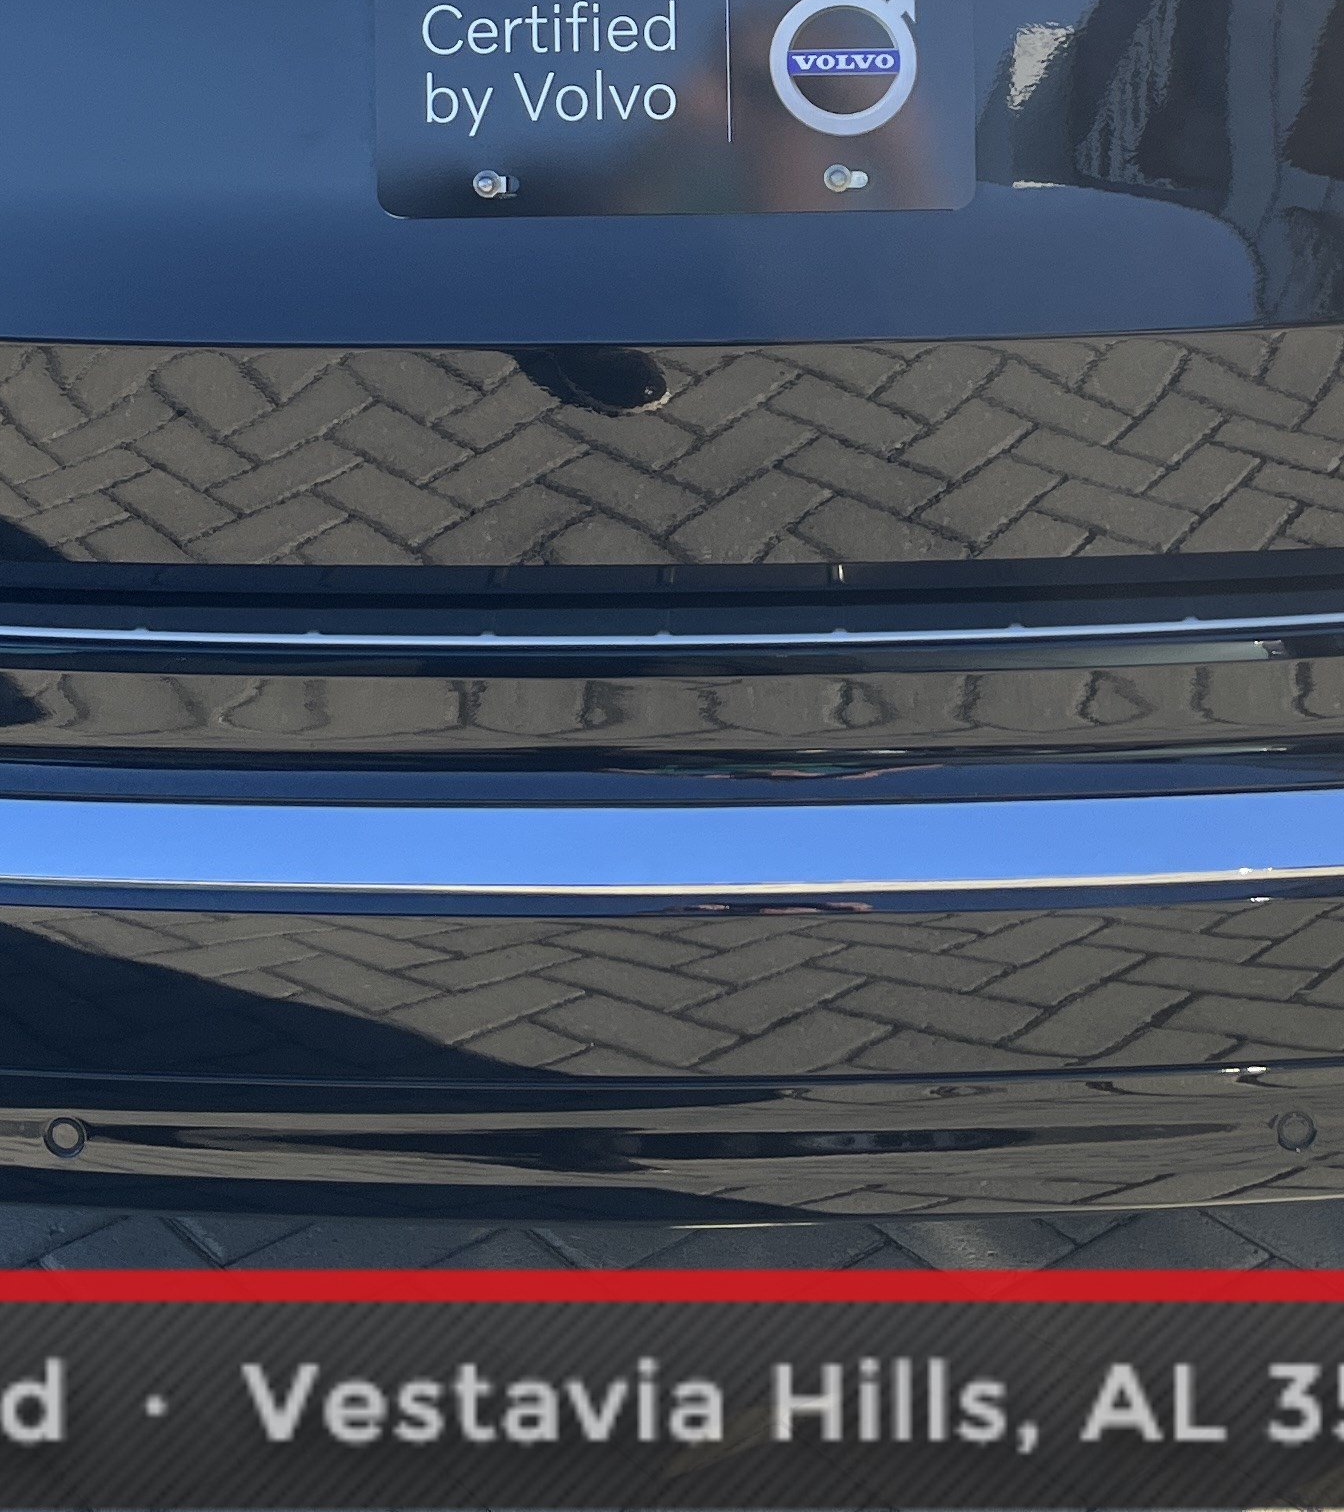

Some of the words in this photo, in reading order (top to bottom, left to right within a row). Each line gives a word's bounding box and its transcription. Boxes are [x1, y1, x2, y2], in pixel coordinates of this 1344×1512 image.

[422, 0, 677, 55] Certified
[792, 52, 895, 72] VOLVO
[426, 70, 494, 136] by
[513, 70, 677, 123] Volvo
